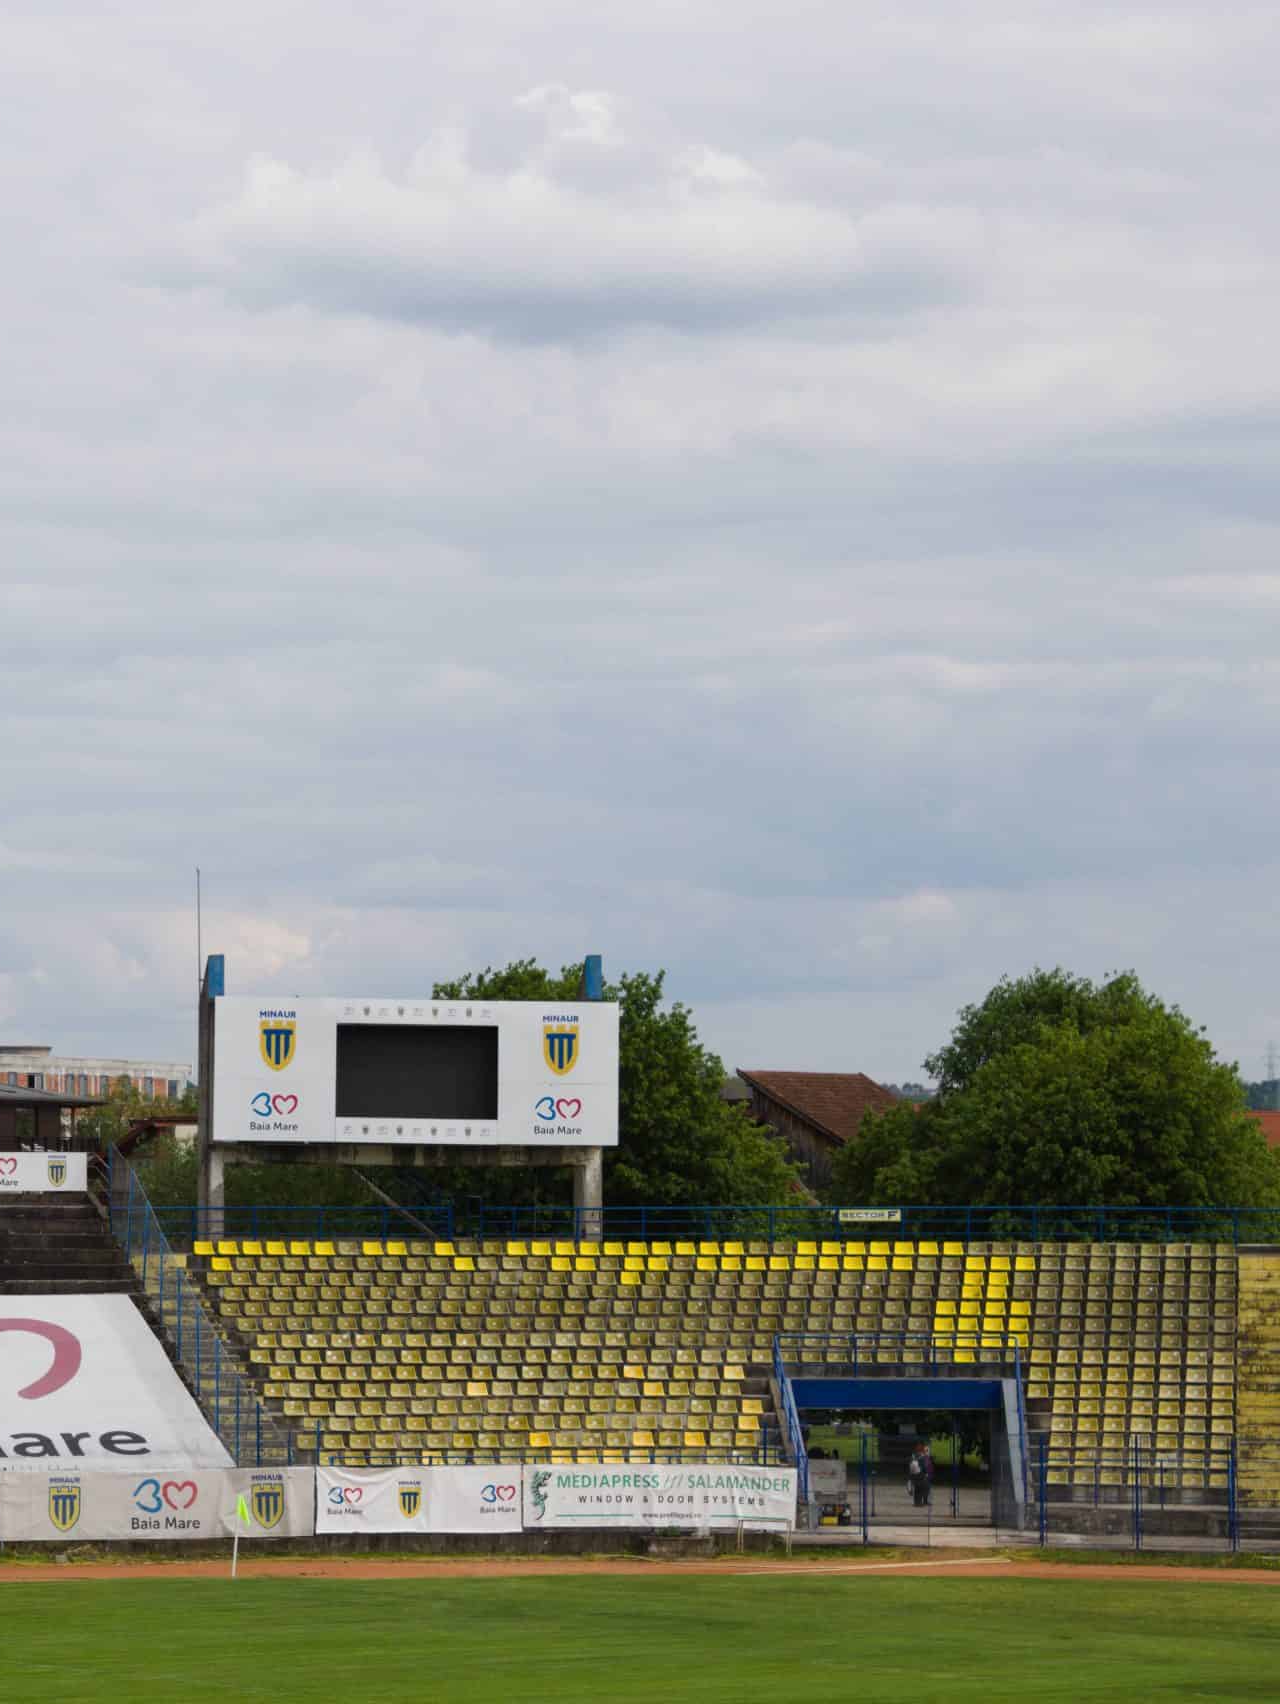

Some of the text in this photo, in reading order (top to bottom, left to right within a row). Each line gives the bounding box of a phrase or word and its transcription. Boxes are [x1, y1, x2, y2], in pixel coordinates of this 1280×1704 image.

[259, 1010, 297, 1018] MINAUR
[542, 1015, 580, 1023] MINAUR
[249, 1121, 299, 1132] Baia Mare
[533, 1125, 583, 1135] Baia Mare
[888, 1210, 897, 1219] F
[557, 1474, 660, 1489] MEDIAPRESS
[687, 1475, 791, 1492] SALAMANDER
[578, 1495, 634, 1504] WINDOW
[657, 1495, 694, 1504] DOOR
[703, 1495, 766, 1507] SYSTEMS
[130, 1516, 201, 1531] Baia Mare
